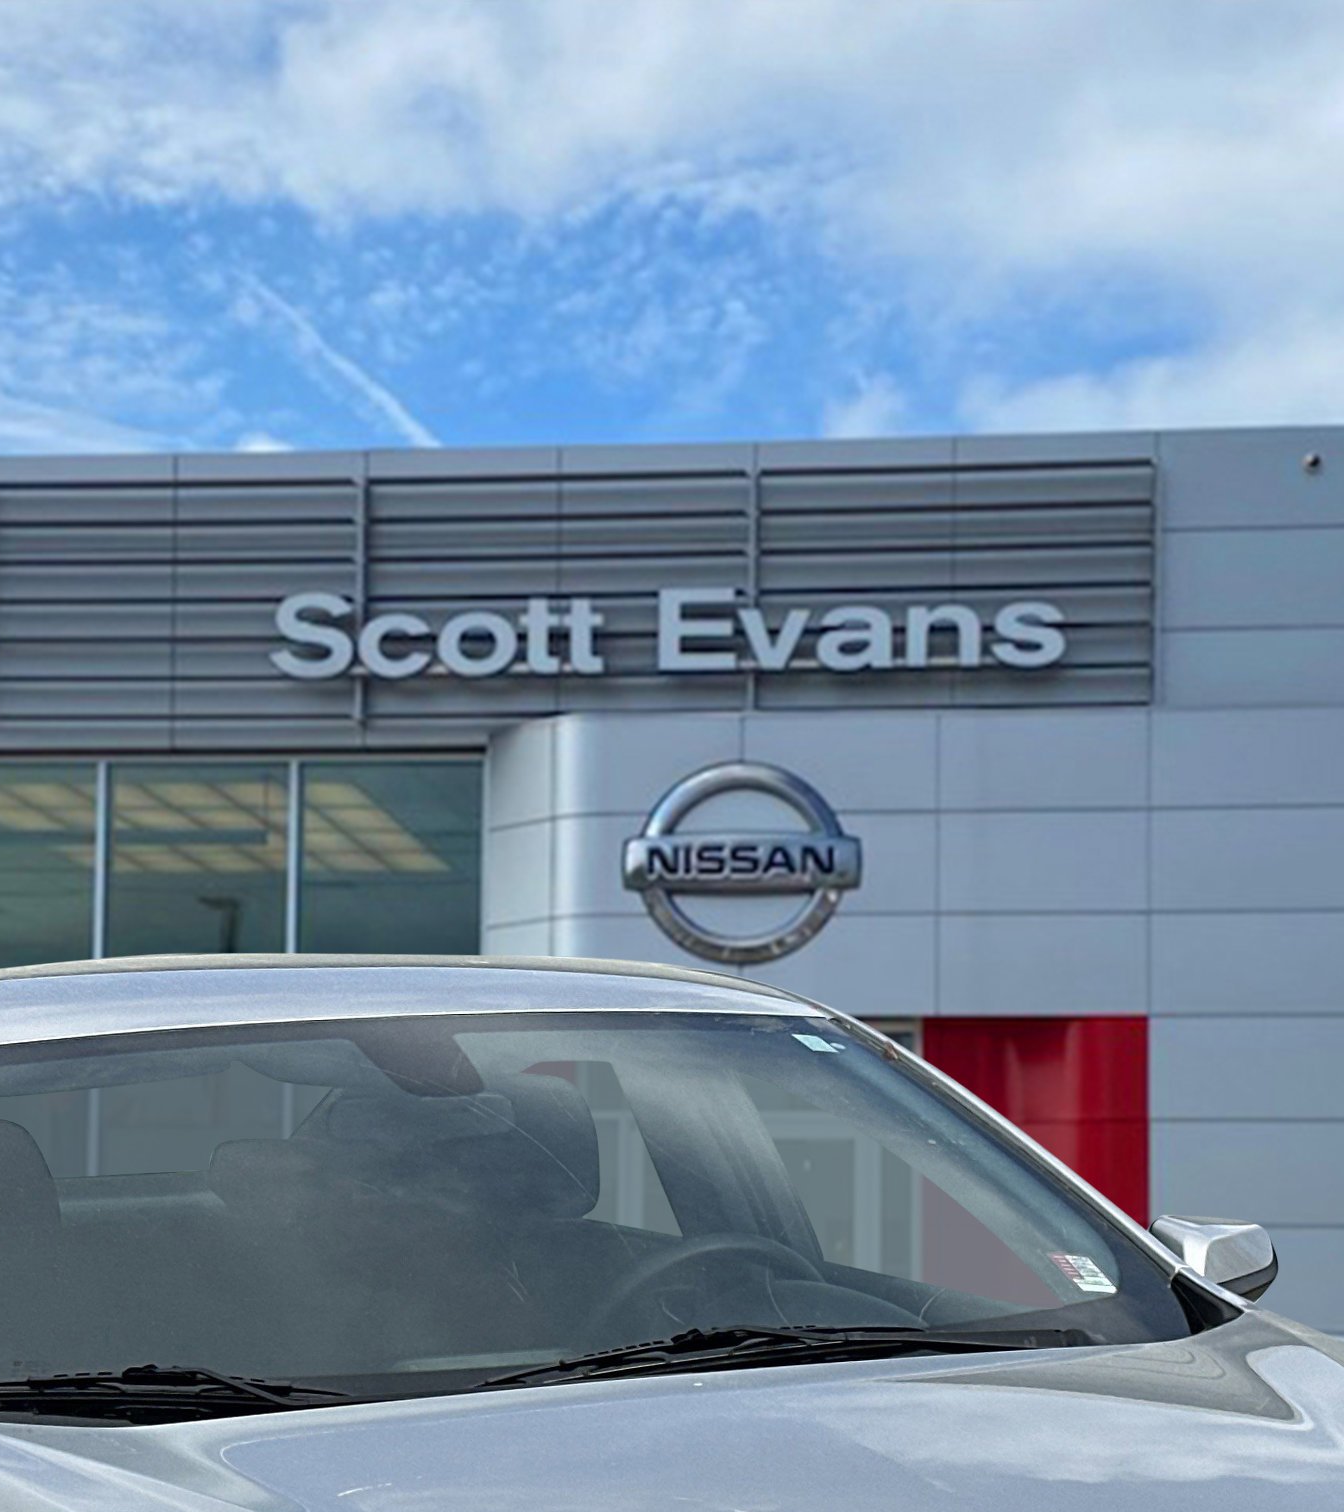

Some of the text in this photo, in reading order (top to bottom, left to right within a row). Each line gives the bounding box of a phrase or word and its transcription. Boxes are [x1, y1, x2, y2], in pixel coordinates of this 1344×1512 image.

[268, 586, 1068, 678] Scott Evans
[646, 845, 835, 876] NISSAN
